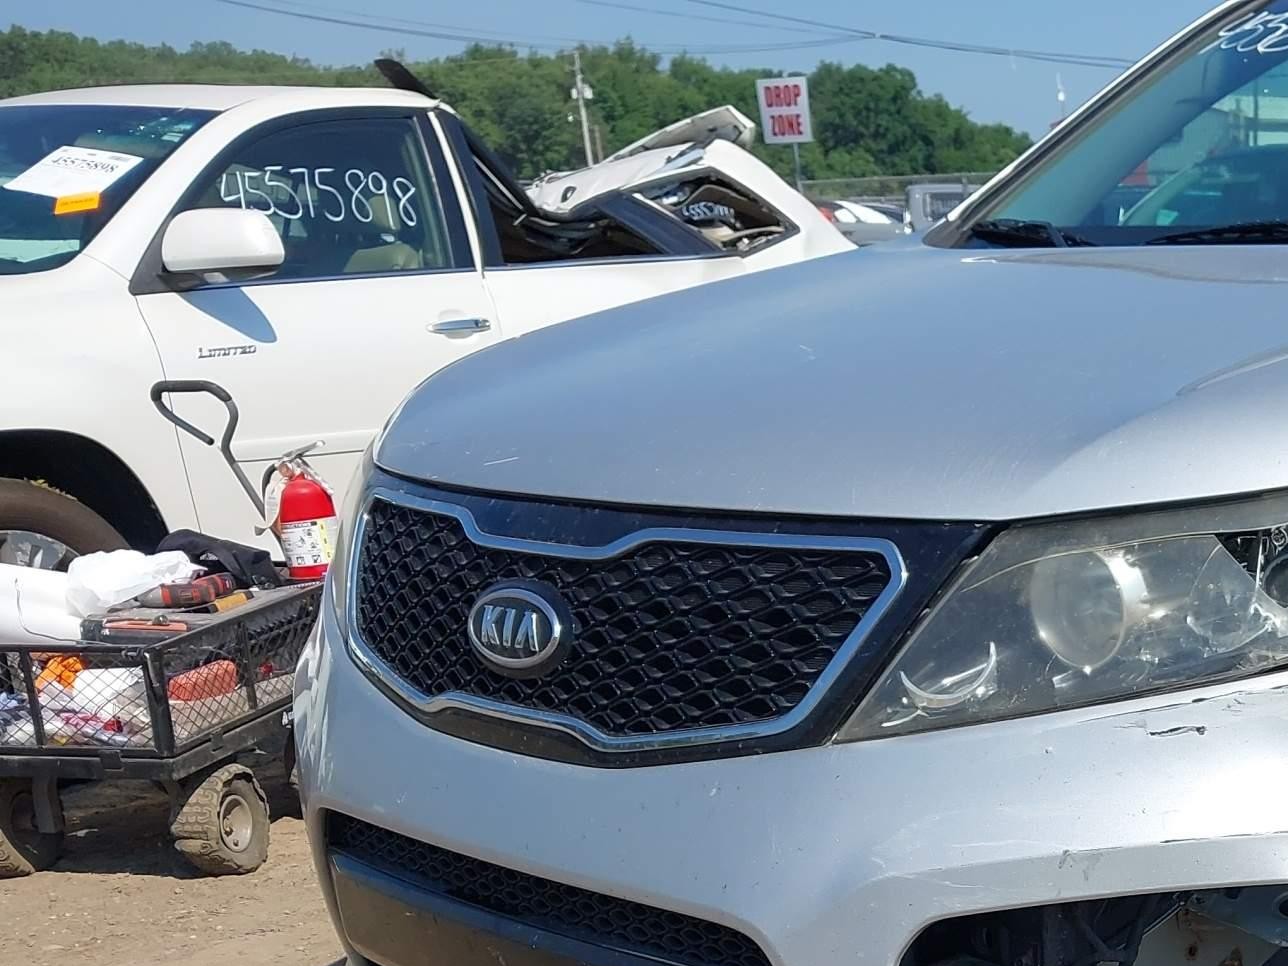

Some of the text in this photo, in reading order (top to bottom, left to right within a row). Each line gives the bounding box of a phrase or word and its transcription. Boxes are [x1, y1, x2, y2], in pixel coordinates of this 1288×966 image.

[763, 84, 801, 108] DROP
[769, 114, 803, 136] ZONE
[220, 165, 416, 227] 45575898
[481, 605, 539, 652] KIA
